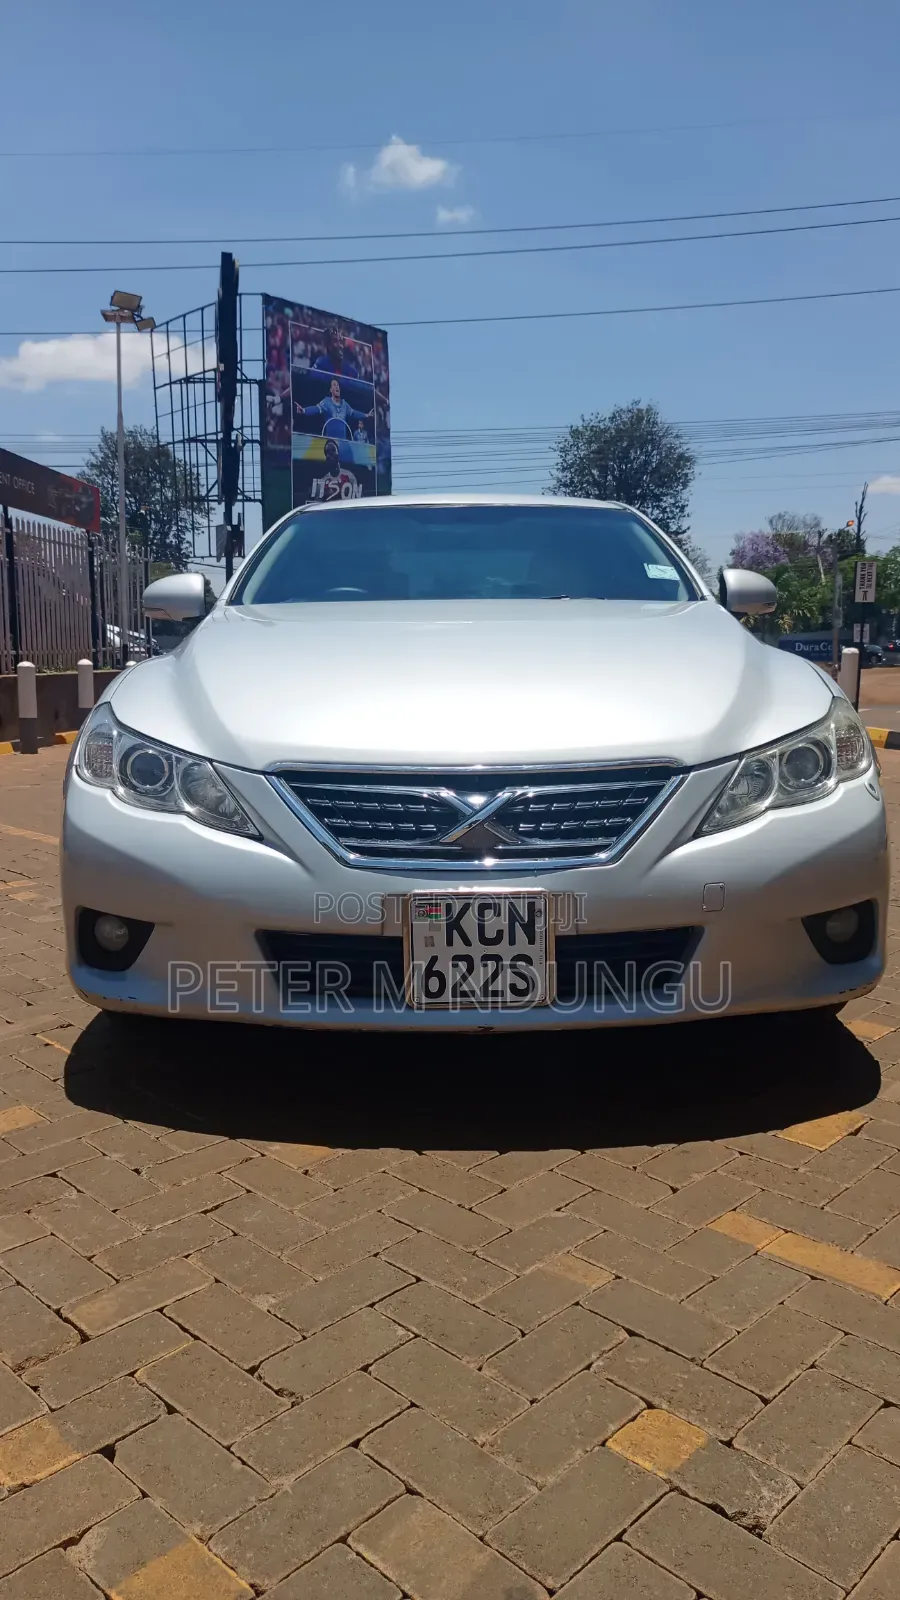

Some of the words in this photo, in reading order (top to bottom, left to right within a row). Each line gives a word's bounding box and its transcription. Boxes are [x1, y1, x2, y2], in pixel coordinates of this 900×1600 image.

[12, 476, 35, 495] OFFICE
[311, 478, 340, 500] IT'S
[341, 482, 363, 499] ON
[445, 901, 536, 947] KCN
[421, 953, 536, 999] 622S
